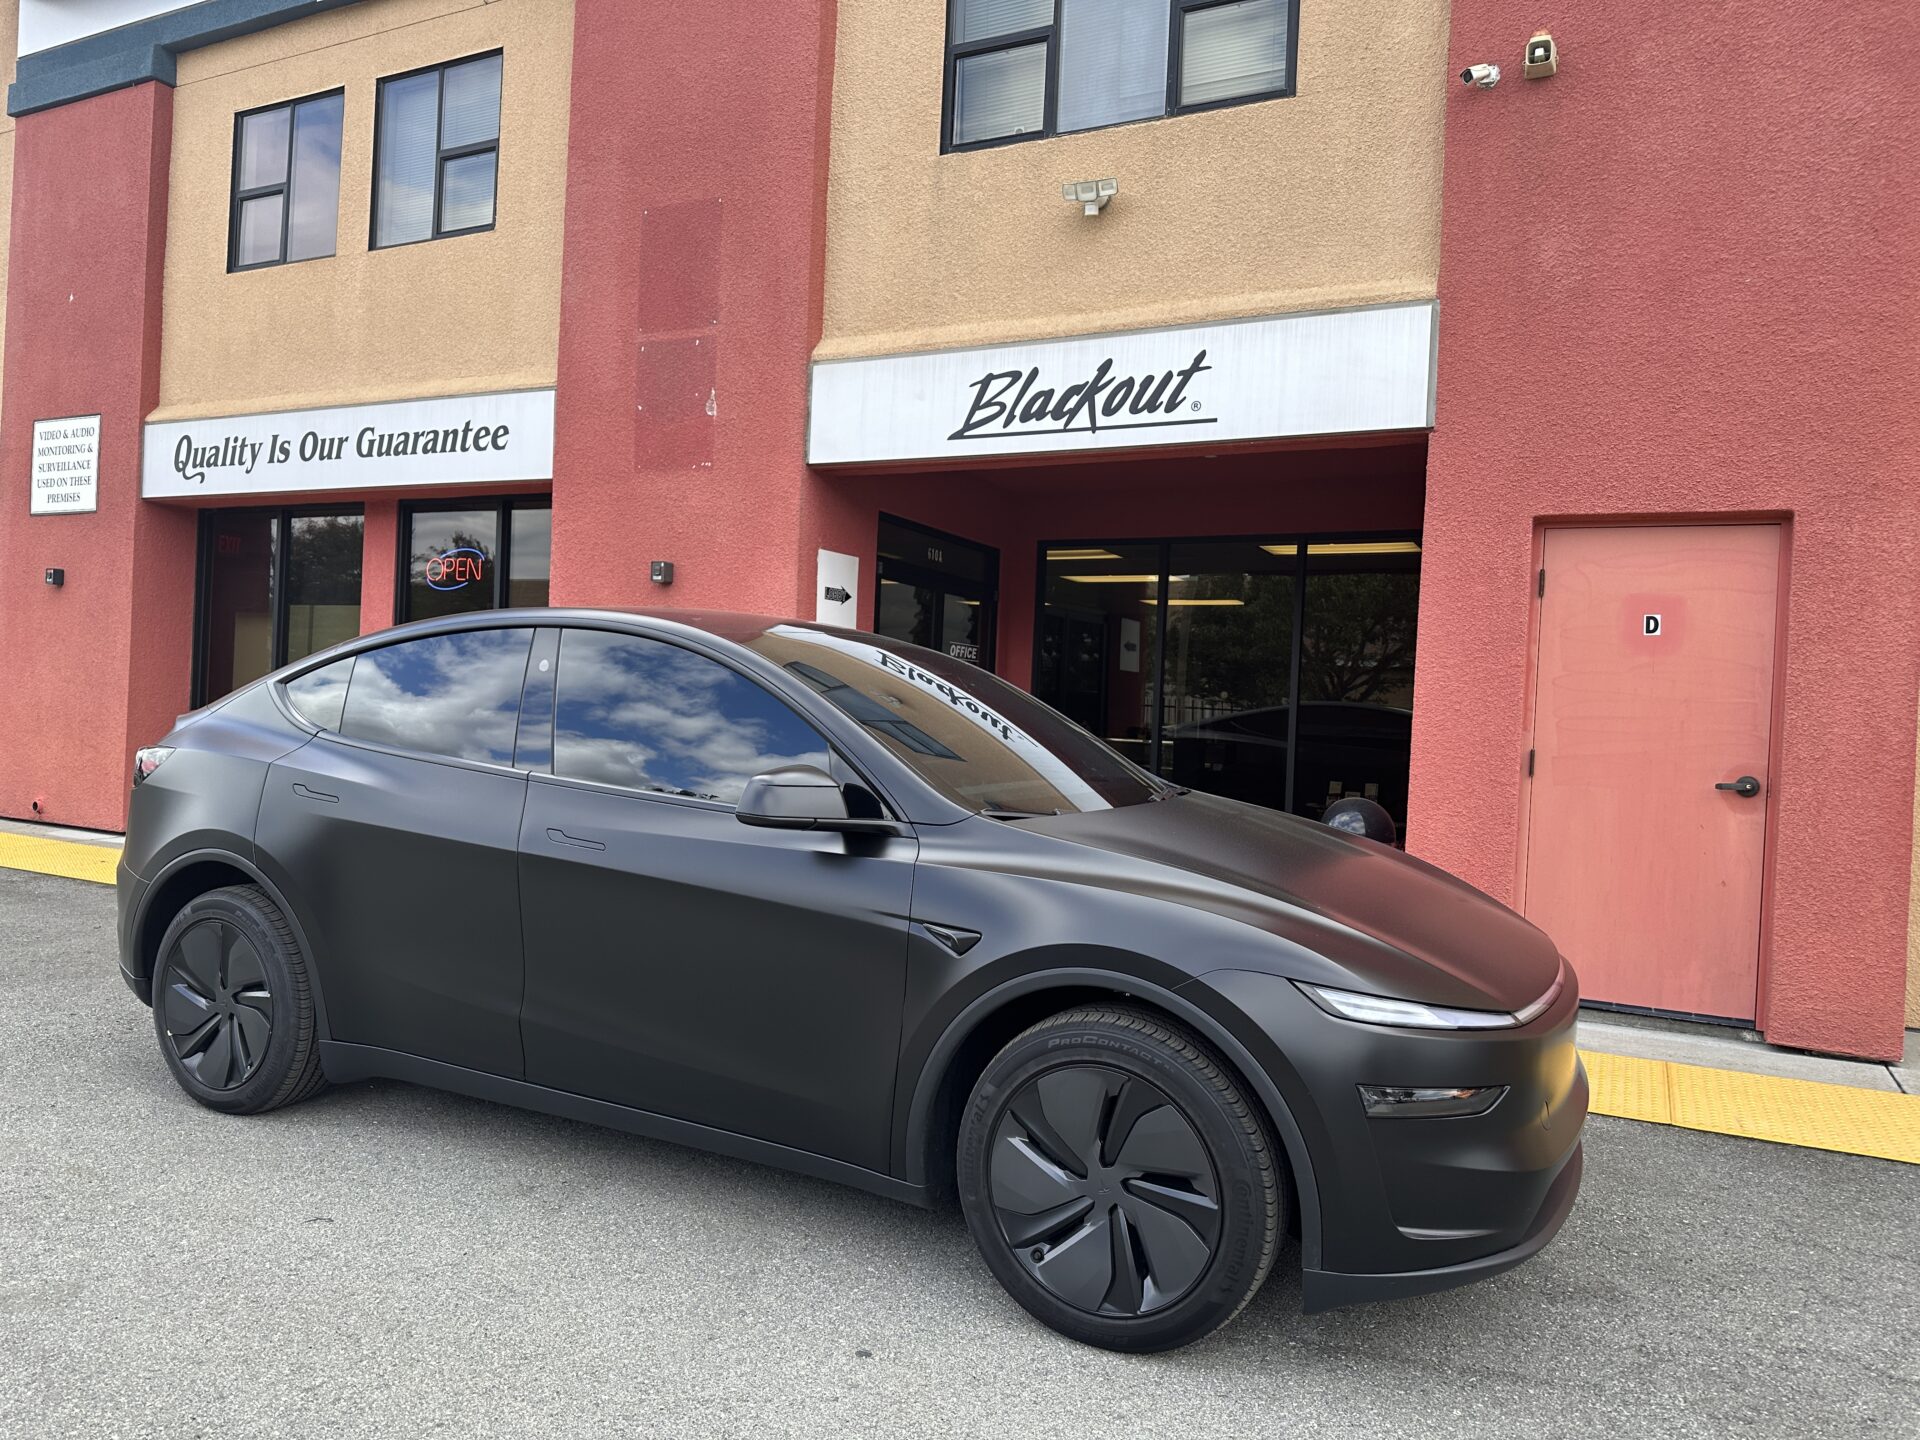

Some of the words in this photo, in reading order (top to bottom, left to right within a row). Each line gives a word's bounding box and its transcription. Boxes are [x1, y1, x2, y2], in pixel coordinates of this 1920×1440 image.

[39, 430, 62, 441] VIDEO
[62, 429, 69, 439] &
[71, 427, 95, 438] AUDIO
[37, 443, 86, 457] MONITORING
[87, 443, 93, 453] &
[174, 434, 263, 484] Quality
[267, 434, 291, 464] Is
[299, 431, 349, 462] Our
[356, 419, 510, 458] Guarantee
[38, 459, 91, 473] SURVEILLANCE
[37, 477, 56, 488] USED
[56, 477, 68, 487] ON
[69, 476, 92, 486] THESE
[47, 492, 81, 504] PREMISES
[425, 557, 483, 582] OPEN
[1645, 615, 1660, 634] D
[949, 644, 978, 660] OFFICE
